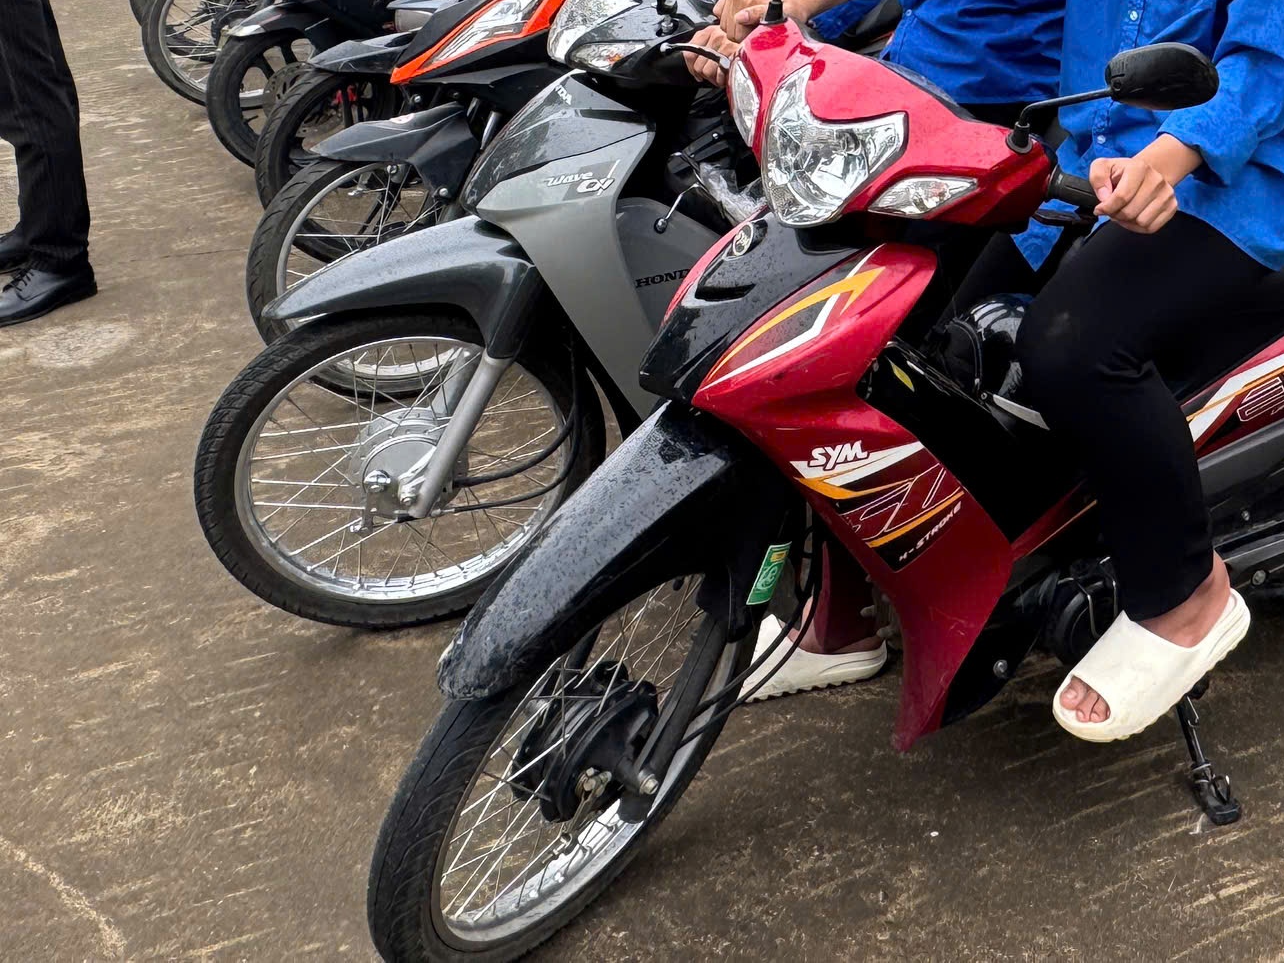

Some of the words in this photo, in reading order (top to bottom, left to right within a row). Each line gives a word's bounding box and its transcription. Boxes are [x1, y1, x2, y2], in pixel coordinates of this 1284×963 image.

[545, 171, 594, 187] Wave
[635, 268, 691, 288] HOND
[808, 439, 868, 470] SYM
